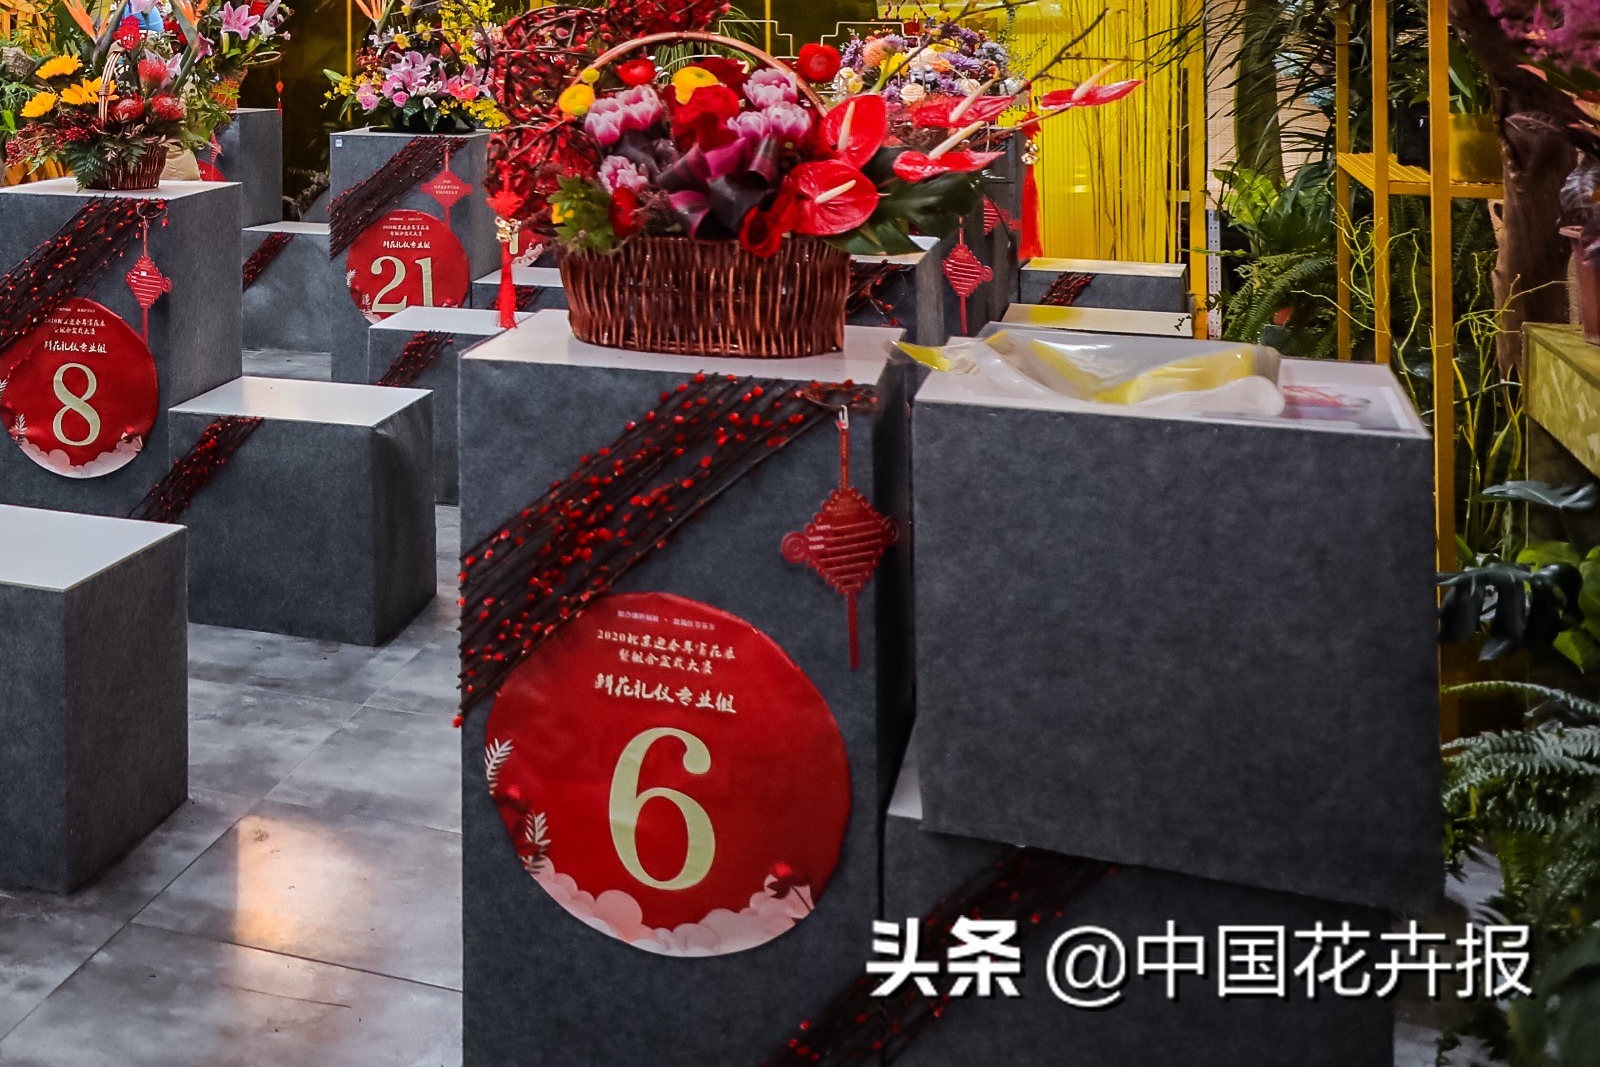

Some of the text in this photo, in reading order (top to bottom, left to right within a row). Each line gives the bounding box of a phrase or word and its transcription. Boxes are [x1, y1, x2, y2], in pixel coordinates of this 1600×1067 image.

[370, 255, 434, 313] 21
[52, 362, 101, 447] 8
[594, 672, 737, 714] 鲜花礼仪专业组
[608, 726, 716, 891] 6
